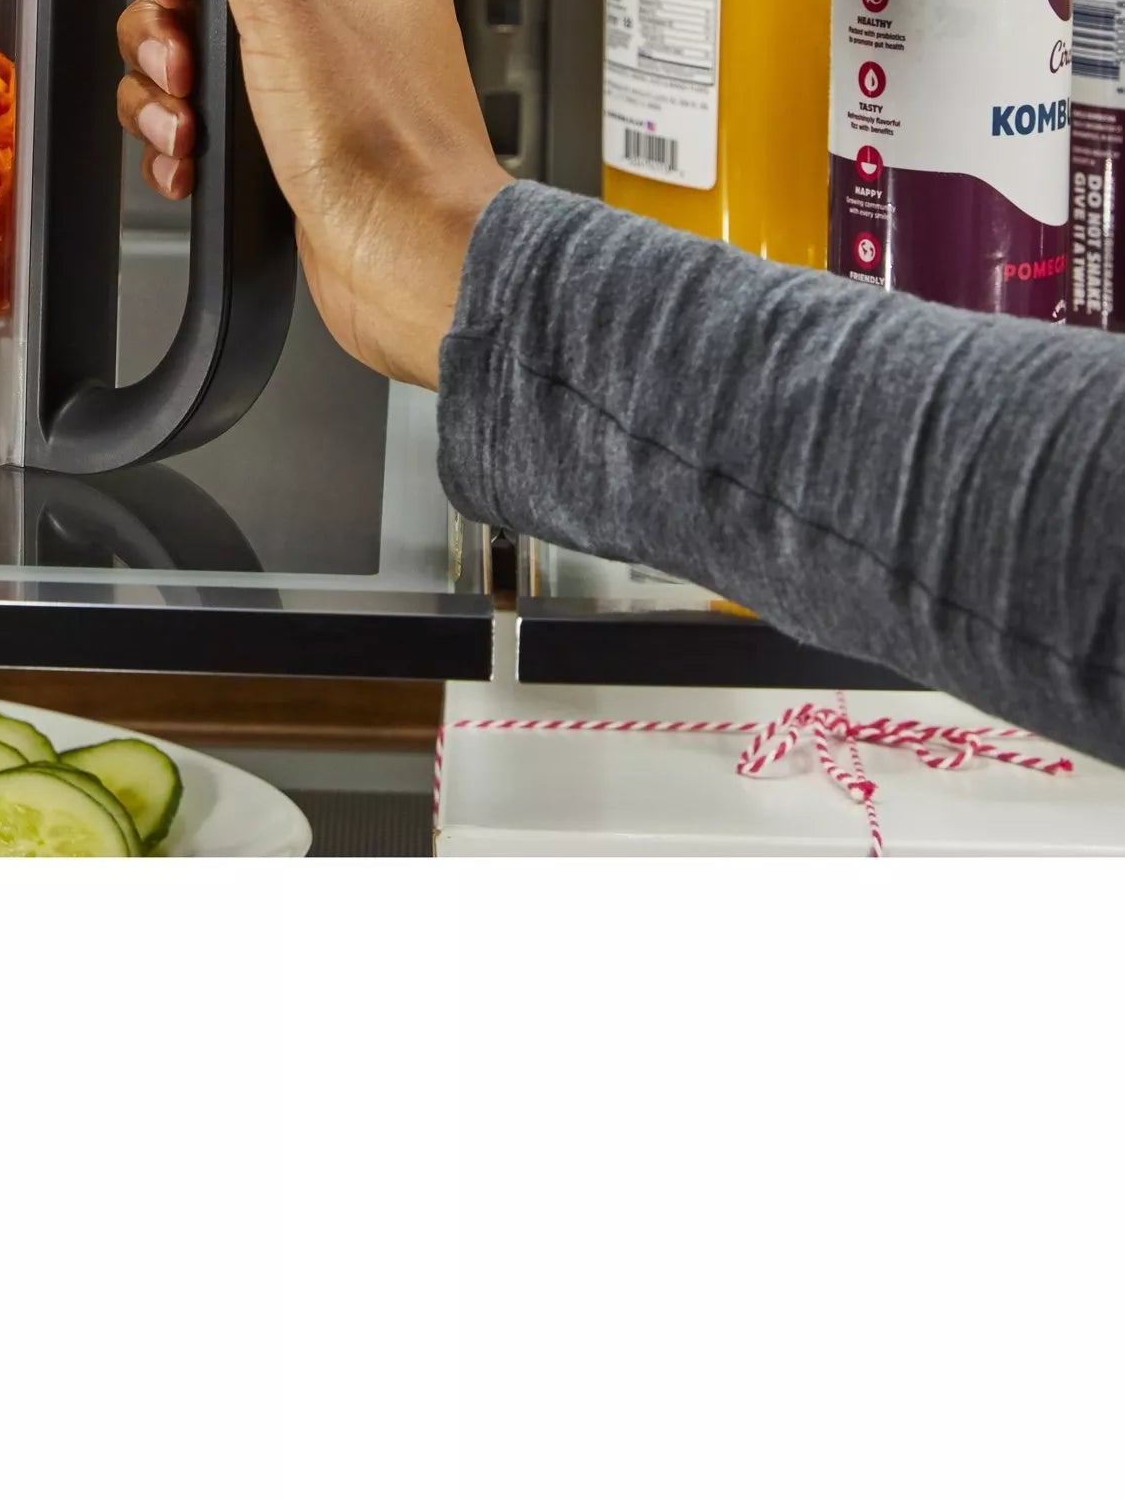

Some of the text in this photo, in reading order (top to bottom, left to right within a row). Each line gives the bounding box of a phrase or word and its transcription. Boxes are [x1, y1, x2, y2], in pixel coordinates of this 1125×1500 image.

[857, 15, 893, 29] HEALTHY
[876, 31, 906, 42] probiotics
[874, 41, 884, 49] gut
[885, 41, 905, 51] health
[858, 101, 884, 114] TASTY
[876, 117, 901, 128] flavorful
[870, 125, 894, 136] benefits
[855, 186, 883, 199] HAPPY
[1073, 171, 1086, 221] GIVE
[1072, 223, 1086, 240] IT
[1073, 241, 1086, 254] A
[1086, 174, 1103, 316] DO NOT SHAKE.
[849, 271, 885, 286] FRIENDLY
